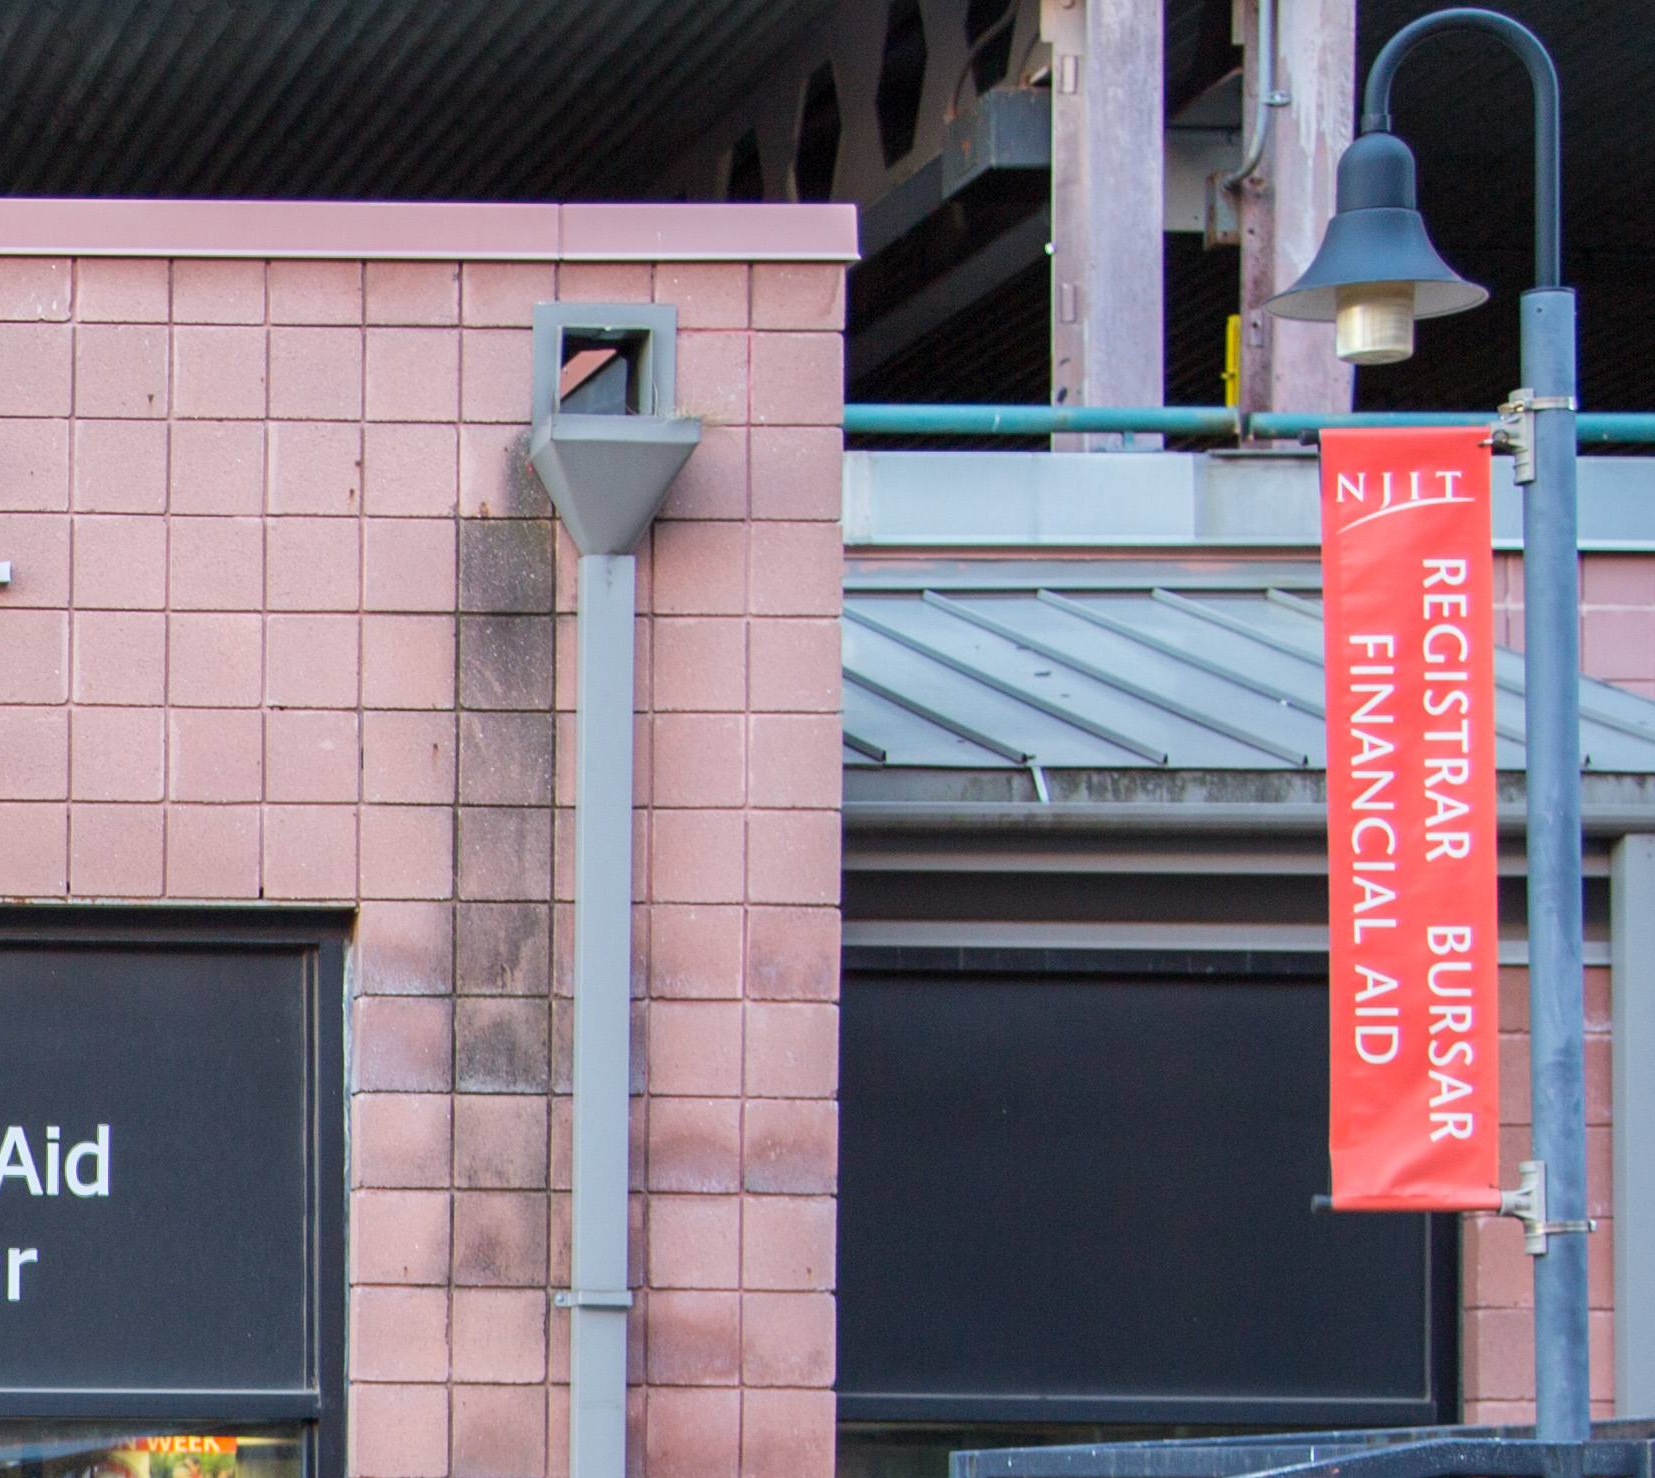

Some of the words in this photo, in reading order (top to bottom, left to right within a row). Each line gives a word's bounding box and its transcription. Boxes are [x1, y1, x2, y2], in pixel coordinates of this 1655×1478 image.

[1336, 471, 1462, 509] NJIT
[1350, 635, 1396, 943] FINANCIAL
[1423, 559, 1470, 861] REGISTRAR
[1355, 965, 1398, 1064] AID
[1428, 927, 1472, 1142] BURSAR
